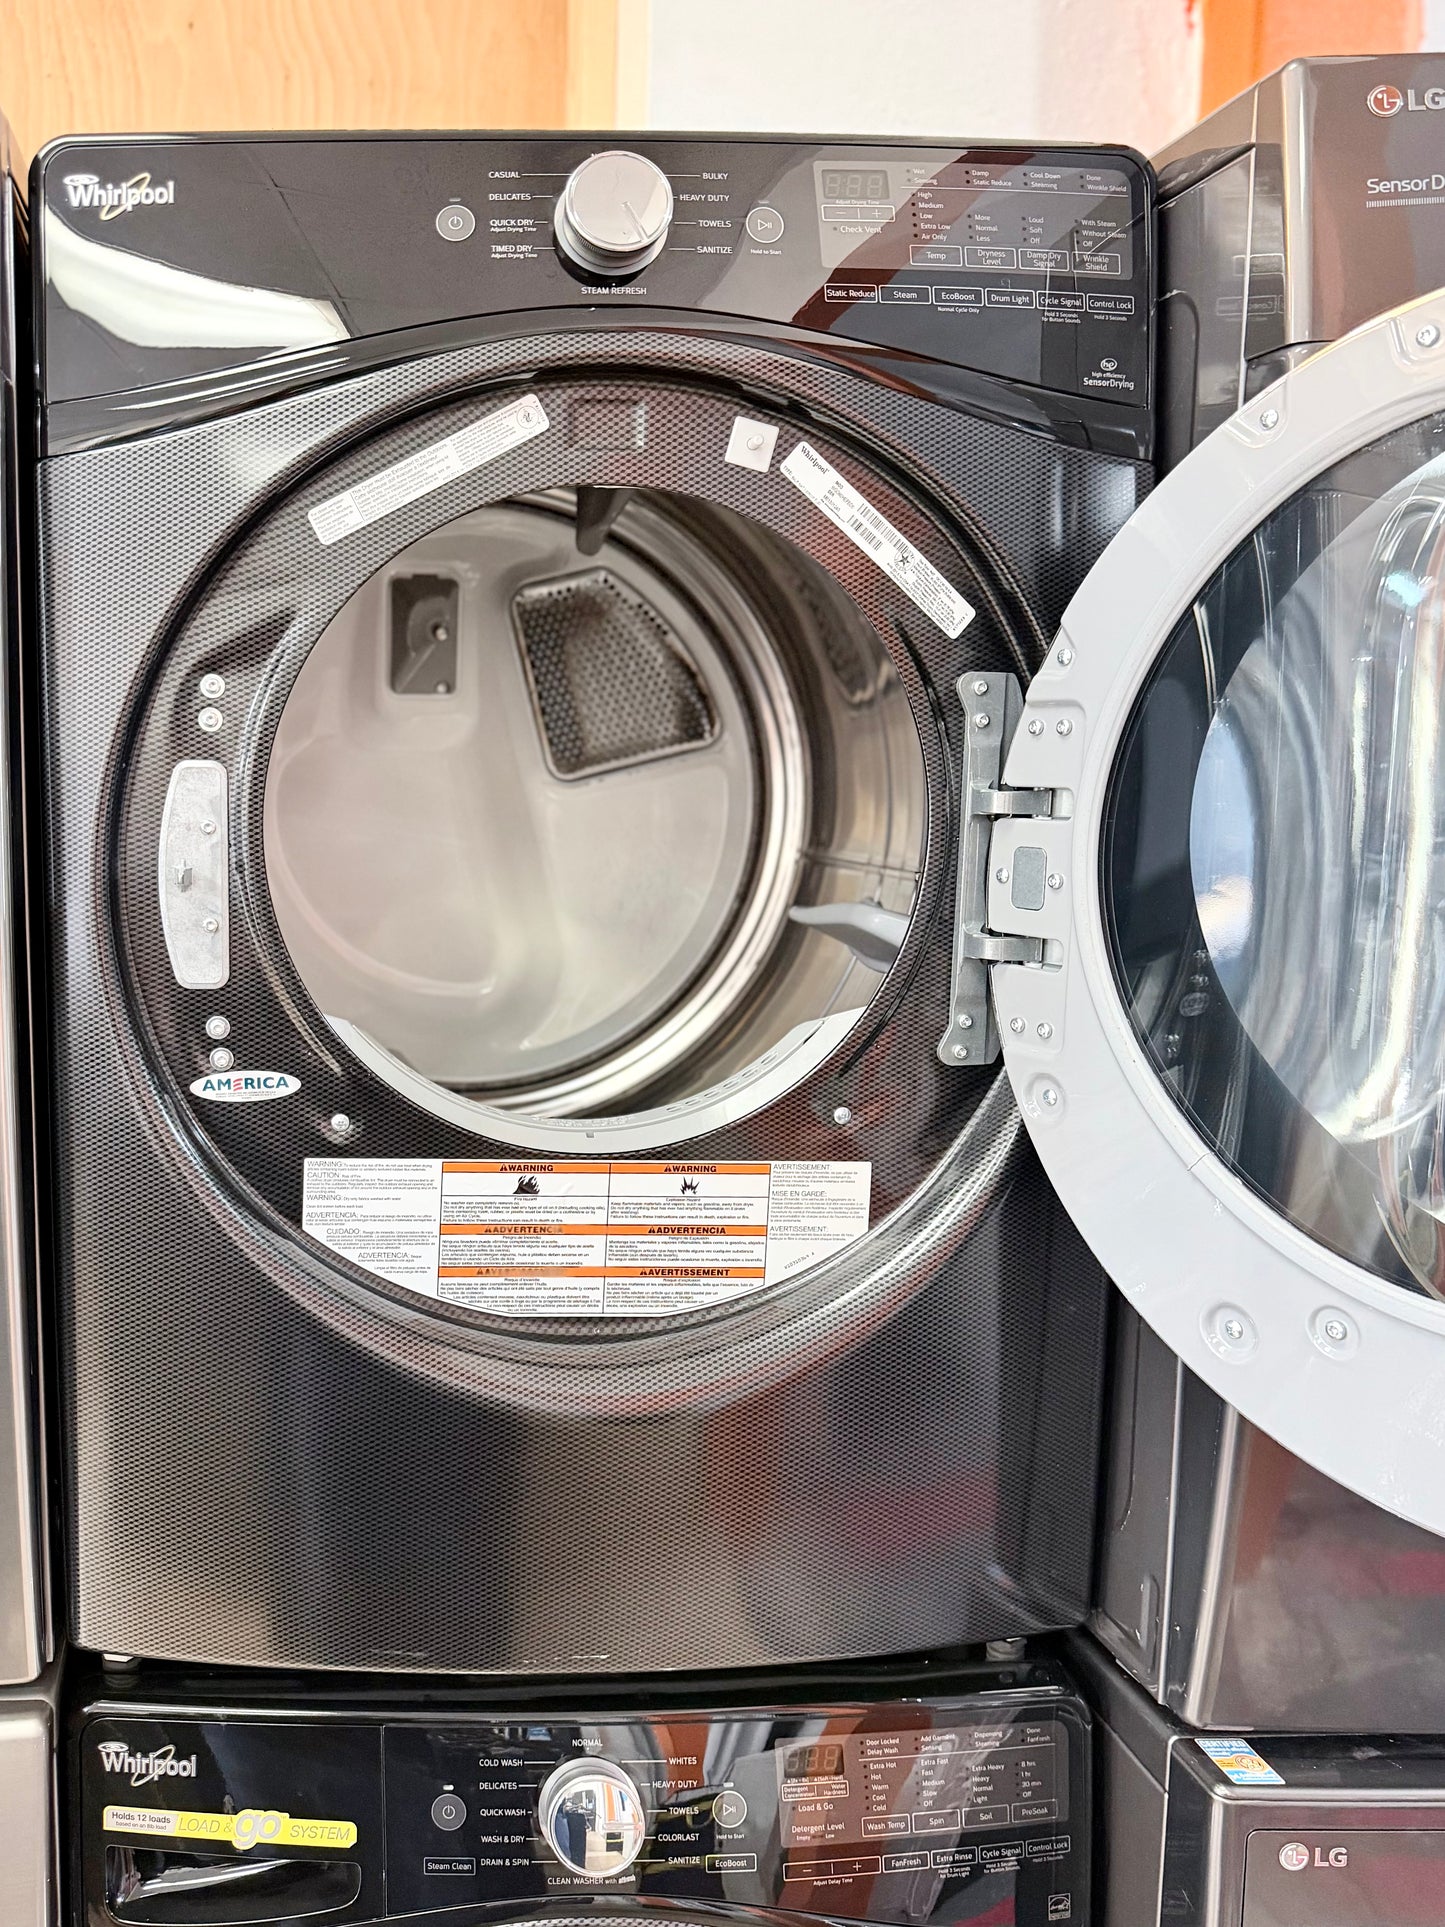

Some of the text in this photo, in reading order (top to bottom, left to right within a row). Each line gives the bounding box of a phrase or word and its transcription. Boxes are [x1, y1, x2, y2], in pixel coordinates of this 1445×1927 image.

[1407, 88, 1445, 111] LG
[488, 171, 520, 179] CASUAL
[702, 172, 728, 180] BULKY
[971, 169, 990, 177] Damp
[1030, 171, 1046, 179] Cool
[1030, 181, 1058, 190] Steaming
[1366, 178, 1429, 194] Sensor
[66, 181, 175, 212] Whirlpool
[488, 193, 531, 201] DELICATES
[679, 194, 705, 202] HEAVY
[917, 191, 933, 199] High
[918, 201, 944, 209] Medium
[489, 218, 534, 226] QUICK DRY
[698, 219, 732, 228] TOWELS
[1028, 216, 1044, 224] Loud
[1081, 219, 1117, 228] With Steam
[840, 225, 882, 234] Check Vent
[920, 222, 937, 230] Extra
[975, 224, 998, 232] Normal
[1029, 226, 1043, 234] Soft
[921, 232, 947, 241] Air Only
[1081, 229, 1127, 239] Without Steam
[1030, 237, 1041, 245] Off
[1082, 240, 1093, 248] Off
[490, 244, 533, 252] TIMED DRY
[696, 245, 733, 254] SANITIZE
[925, 251, 947, 260] Temp
[977, 249, 1006, 258] Dryness
[1026, 250, 1062, 261] Damp Dry
[983, 257, 1002, 265] Level
[1082, 254, 1110, 263] Wrinkle
[1033, 259, 1056, 269] Signal
[1085, 262, 1108, 271] Shield
[581, 286, 647, 295] STEAM REFRESH
[826, 288, 876, 298] Static Reduce
[893, 290, 918, 299] Steam
[941, 291, 976, 300] EcoBoost
[990, 293, 1030, 304] Drum Light
[1040, 296, 1083, 307] Cycle Signal
[1089, 299, 1132, 309] Control Lock
[1083, 377, 1135, 391] SensorDrying
[800, 444, 830, 476] Whirlpool
[202, 1076, 289, 1092] AMERICA
[508, 1164, 554, 1172] WARNING
[672, 1165, 717, 1173] WARNING
[657, 1226, 726, 1234] ADVERTENCIA
[649, 1268, 731, 1276] AVERTISSEMENT
[572, 1739, 603, 1747] NORMAL
[478, 1759, 523, 1767] COLD WASH
[668, 1757, 697, 1765] WHITES
[101, 1752, 198, 1781] Whirlpool
[987, 1763, 1005, 1772] Heavy
[922, 1779, 946, 1787] Medium
[972, 1775, 990, 1783] Heavy
[479, 1781, 518, 1790] DELICATES
[652, 1780, 698, 1789] HEAVY DUTY
[798, 1802, 834, 1812] Load & Go
[923, 1800, 933, 1808] Off
[480, 1808, 526, 1817] QUICK WASH
[669, 1806, 699, 1815] TOWELS
[1021, 1806, 1049, 1816] PreSoak
[111, 1811, 171, 1824] Holds 12 loads
[979, 1812, 993, 1821] Soil
[867, 1820, 906, 1831] Wash Temp
[929, 1817, 945, 1826] Spin
[178, 1812, 350, 1847] LOAD & go SYSTEM
[791, 1821, 845, 1834] Detergent Level
[480, 1835, 525, 1843] WASH & DRY
[657, 1833, 700, 1842] COLORLAST
[1028, 1841, 1068, 1853] Control Lock
[936, 1852, 973, 1863] Extra Rinse
[982, 1846, 1022, 1860] Cycle Signal
[1313, 1846, 1348, 1868] LG
[480, 1858, 530, 1866] DRAIN & SPIN
[668, 1856, 700, 1865] SANITIZE
[715, 1859, 747, 1868] EcoBoost
[891, 1858, 922, 1868] FanFresh
[427, 1862, 472, 1871] Steam Clean
[547, 1877, 571, 1885] CLEAN
[572, 1877, 604, 1885] WASHER
